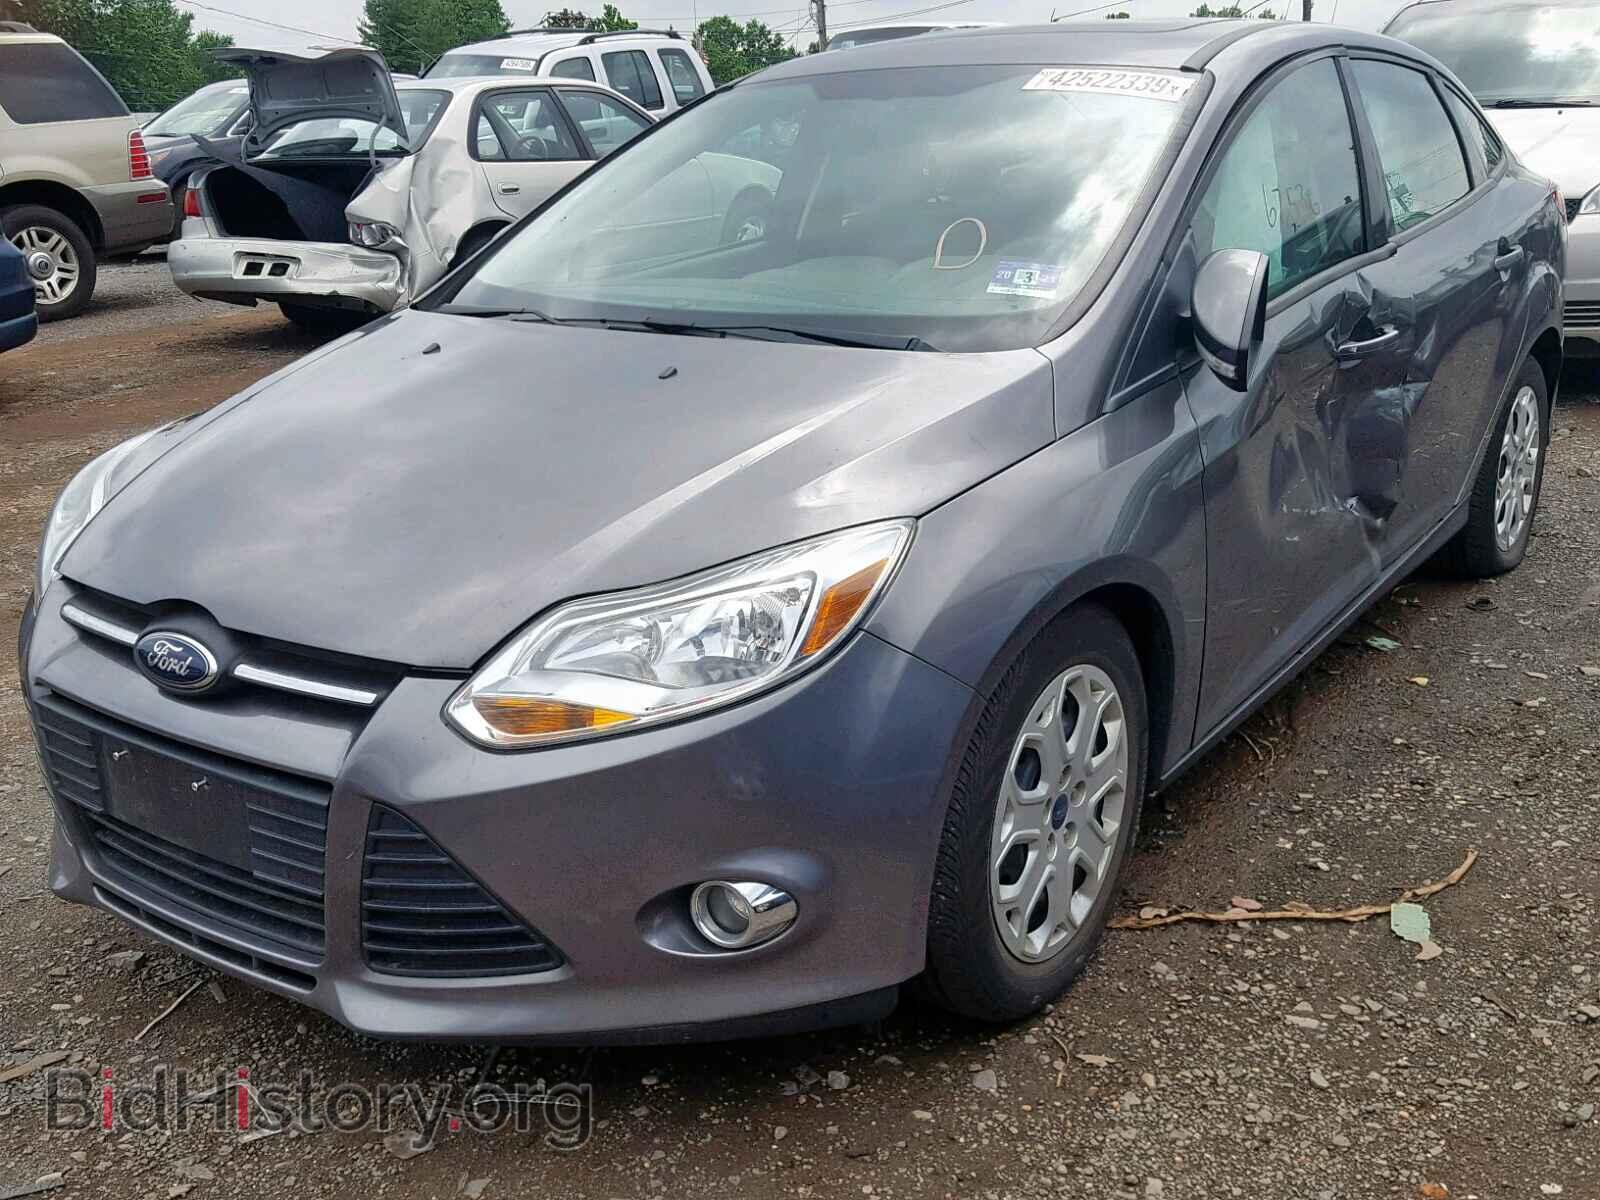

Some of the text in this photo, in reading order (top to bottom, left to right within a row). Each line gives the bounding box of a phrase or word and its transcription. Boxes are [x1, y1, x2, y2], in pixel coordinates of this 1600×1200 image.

[1048, 71, 1171, 93] 42522339
[1023, 271, 1033, 284] 3
[147, 640, 192, 677] Ford
